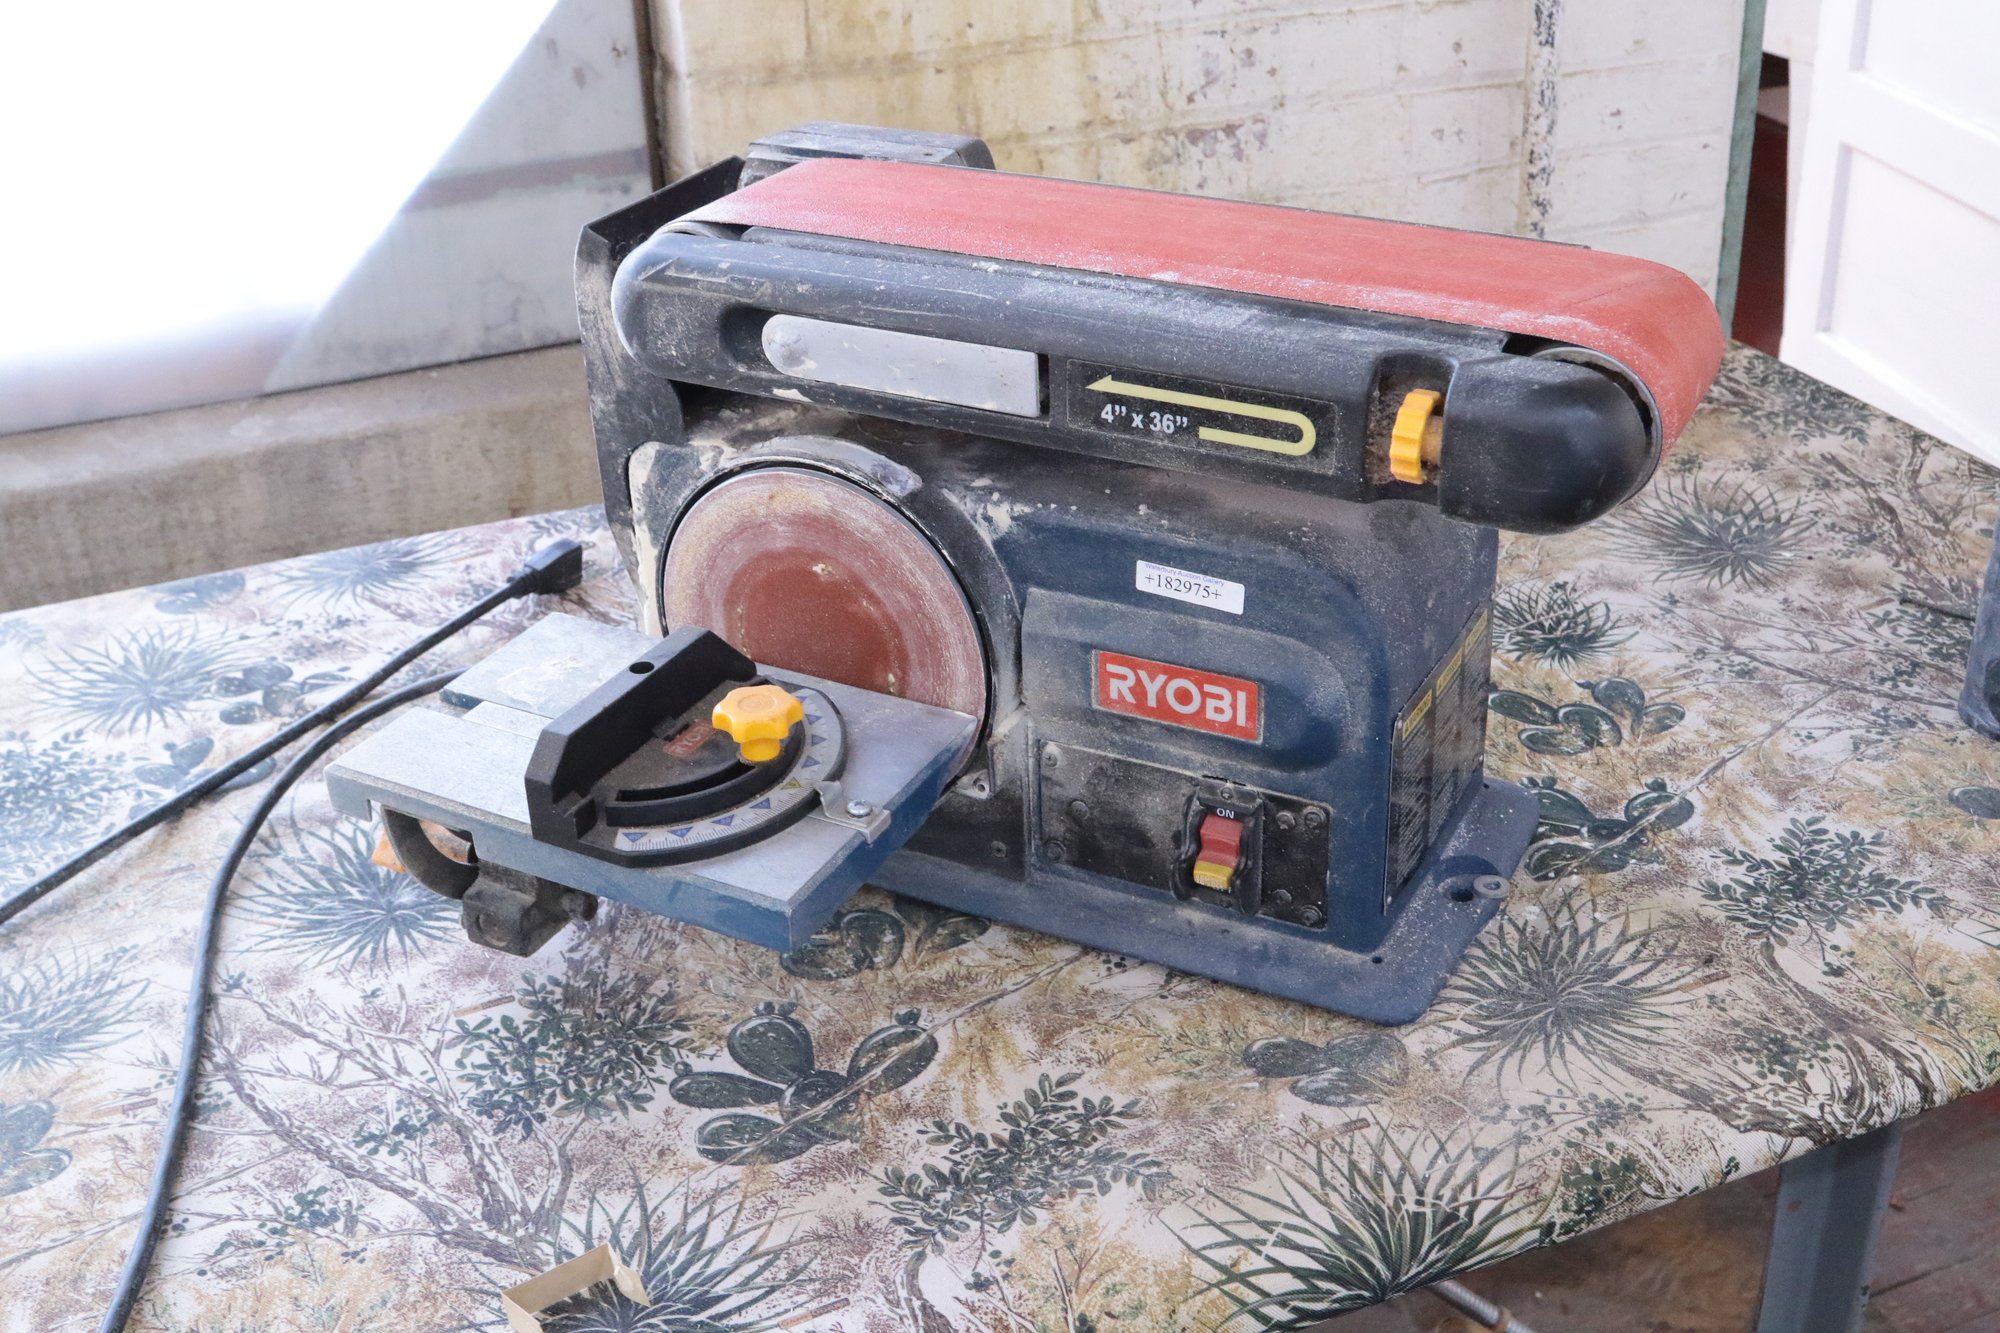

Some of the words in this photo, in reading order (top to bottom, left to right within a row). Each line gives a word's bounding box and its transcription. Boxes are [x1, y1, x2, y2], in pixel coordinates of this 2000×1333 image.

[1131, 412, 1144, 429] x
[1106, 663, 1246, 726] RYOBI
[1216, 808, 1235, 819] ON
